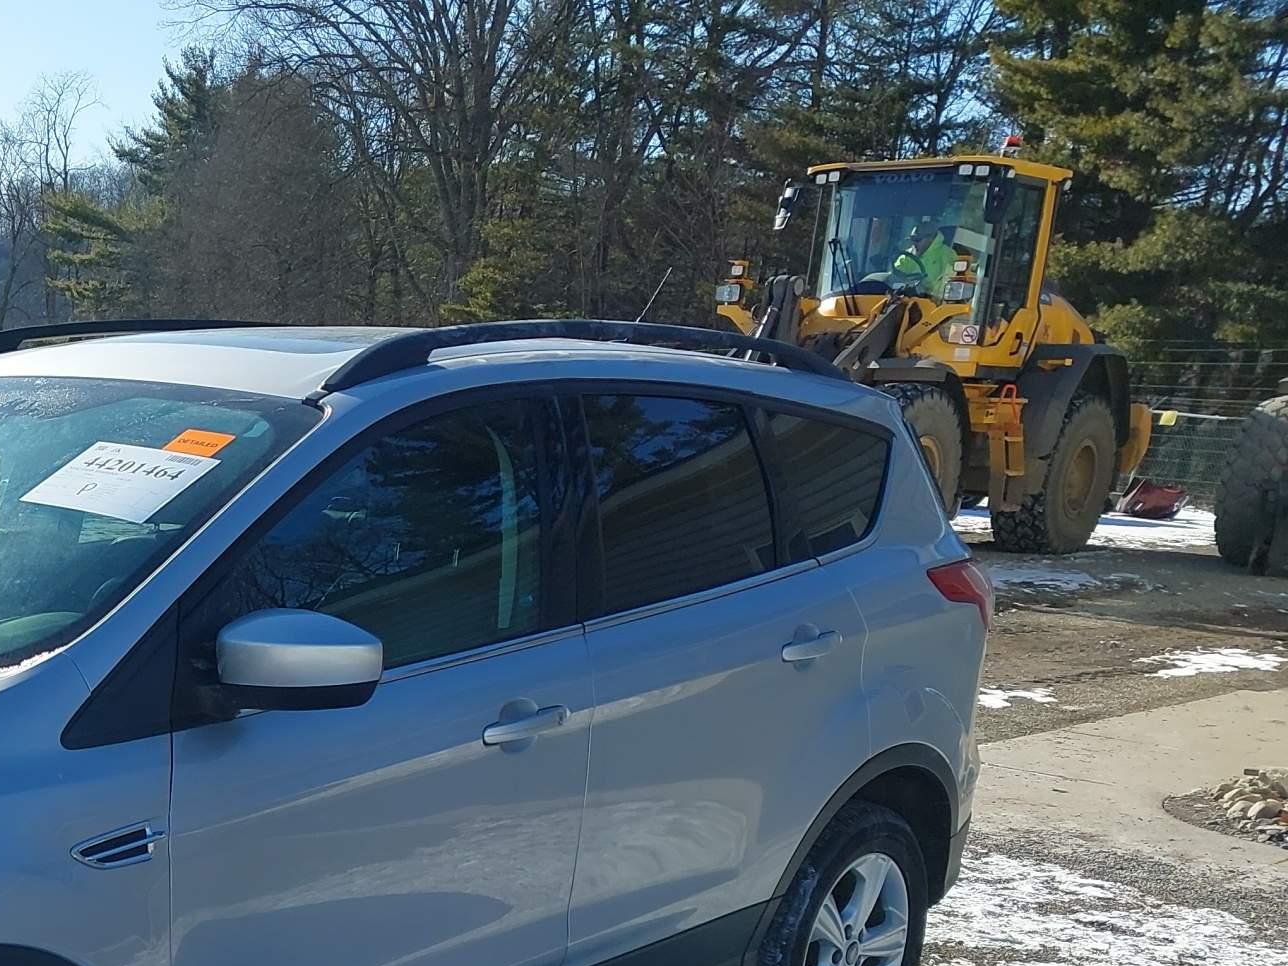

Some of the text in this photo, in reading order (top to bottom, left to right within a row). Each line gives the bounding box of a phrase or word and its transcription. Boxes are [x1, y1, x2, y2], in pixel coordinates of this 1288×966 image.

[874, 172, 935, 184] VOLVO
[177, 439, 218, 448] DETAILED
[84, 456, 186, 481] 44201464
